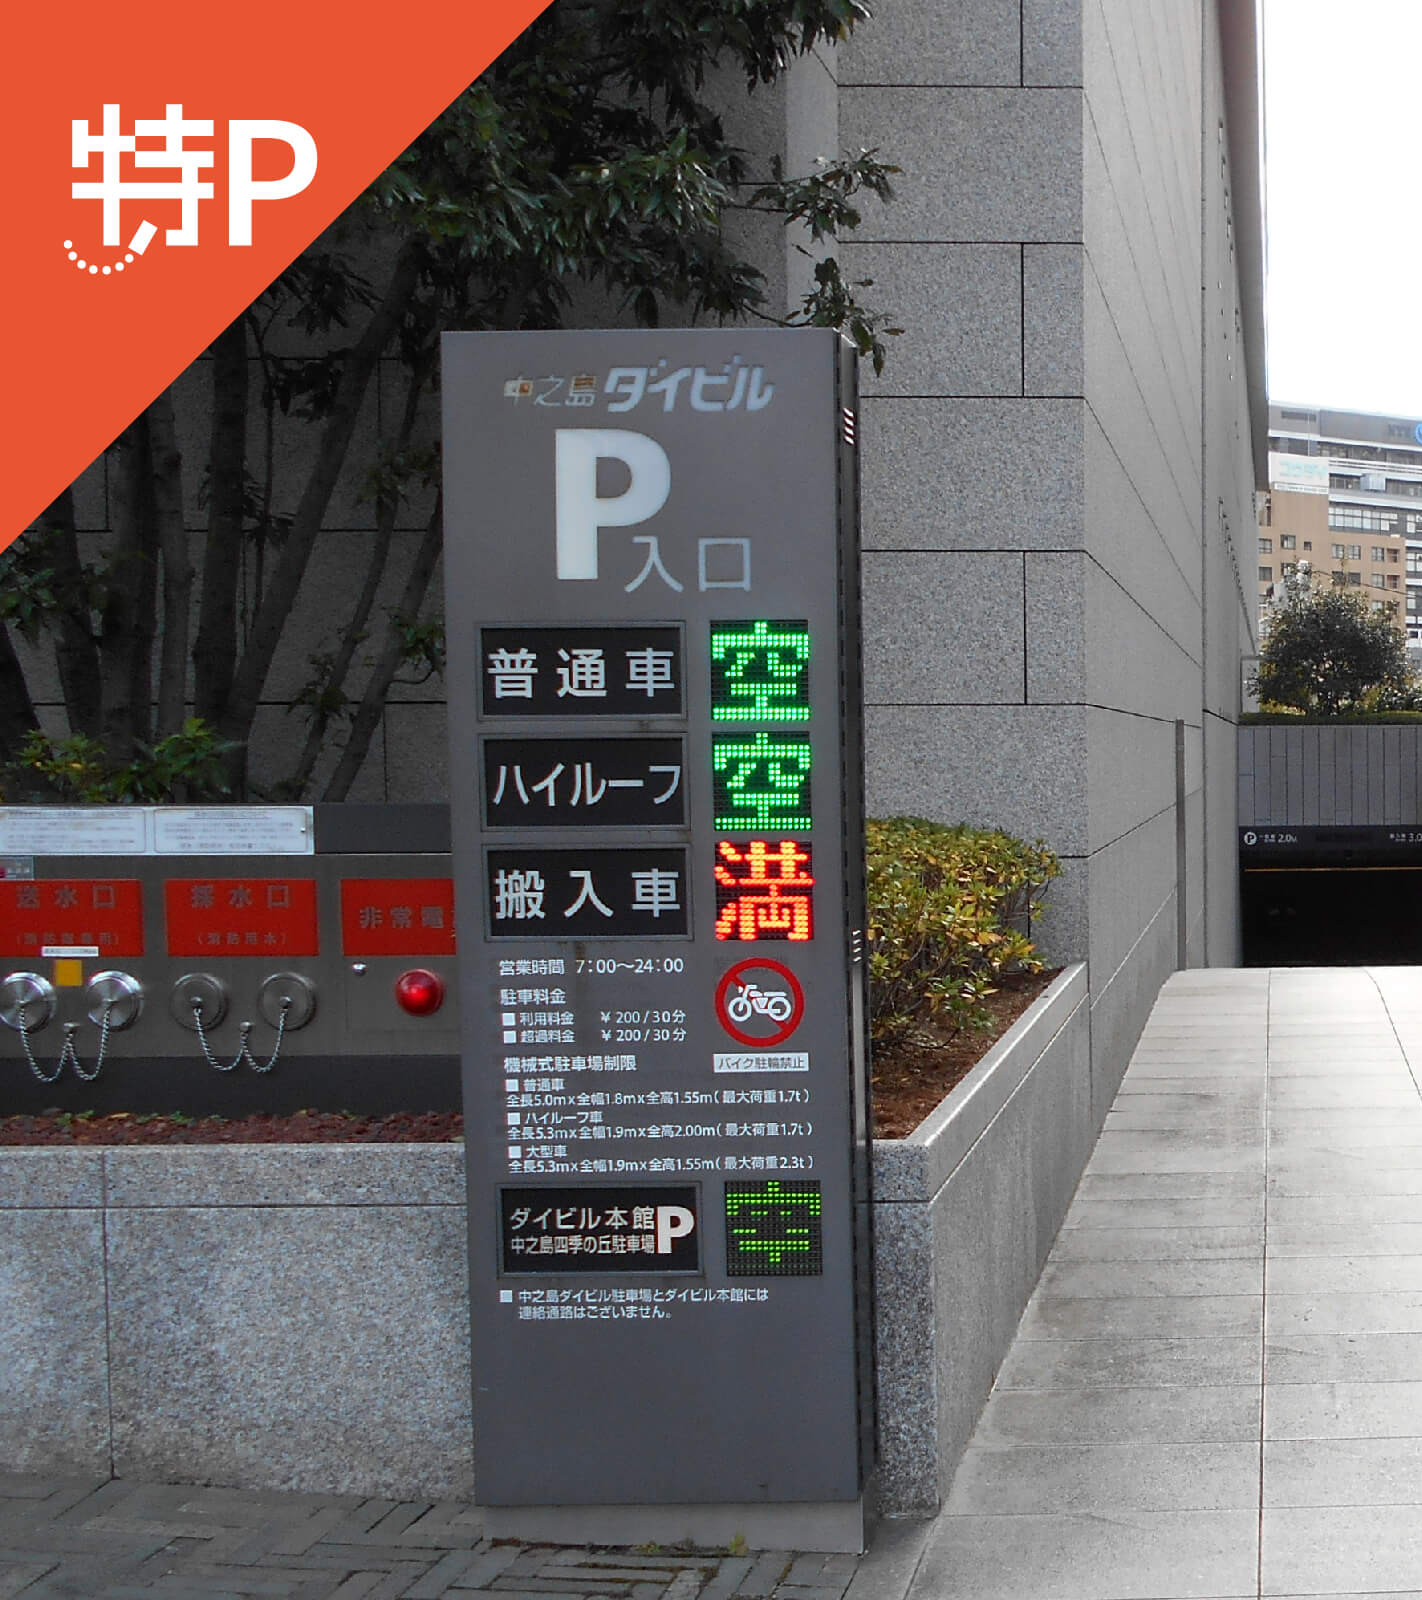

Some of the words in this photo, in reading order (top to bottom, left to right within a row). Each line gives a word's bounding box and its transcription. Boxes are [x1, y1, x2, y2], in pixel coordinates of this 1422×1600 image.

[556, 429, 671, 580] P
[625, 536, 751, 592] 入口
[488, 647, 675, 699] 普通車
[711, 621, 810, 721] 空
[493, 762, 681, 807] ハイルーフ
[713, 731, 812, 831] 空
[495, 868, 681, 920] 搬入車
[714, 840, 816, 941] 満
[499, 959, 565, 976] 営業時間
[500, 988, 566, 1006] 駐車料金
[519, 1011, 575, 1027] 利用料金
[519, 1029, 576, 1044] 超過料金
[504, 1055, 638, 1074] 機械式駐車場制限
[523, 1078, 566, 1093] 普通車
[525, 1110, 604, 1125] ハイルーフ車
[526, 1144, 569, 1159] 大型車
[510, 1206, 655, 1230] ダイビル本館
[657, 1205, 695, 1254] P
[511, 1235, 655, 1255] 中之島四季の丘駐車場
[518, 1288, 769, 1304] 中之島ダイビル駐車場とダイビル本館には
